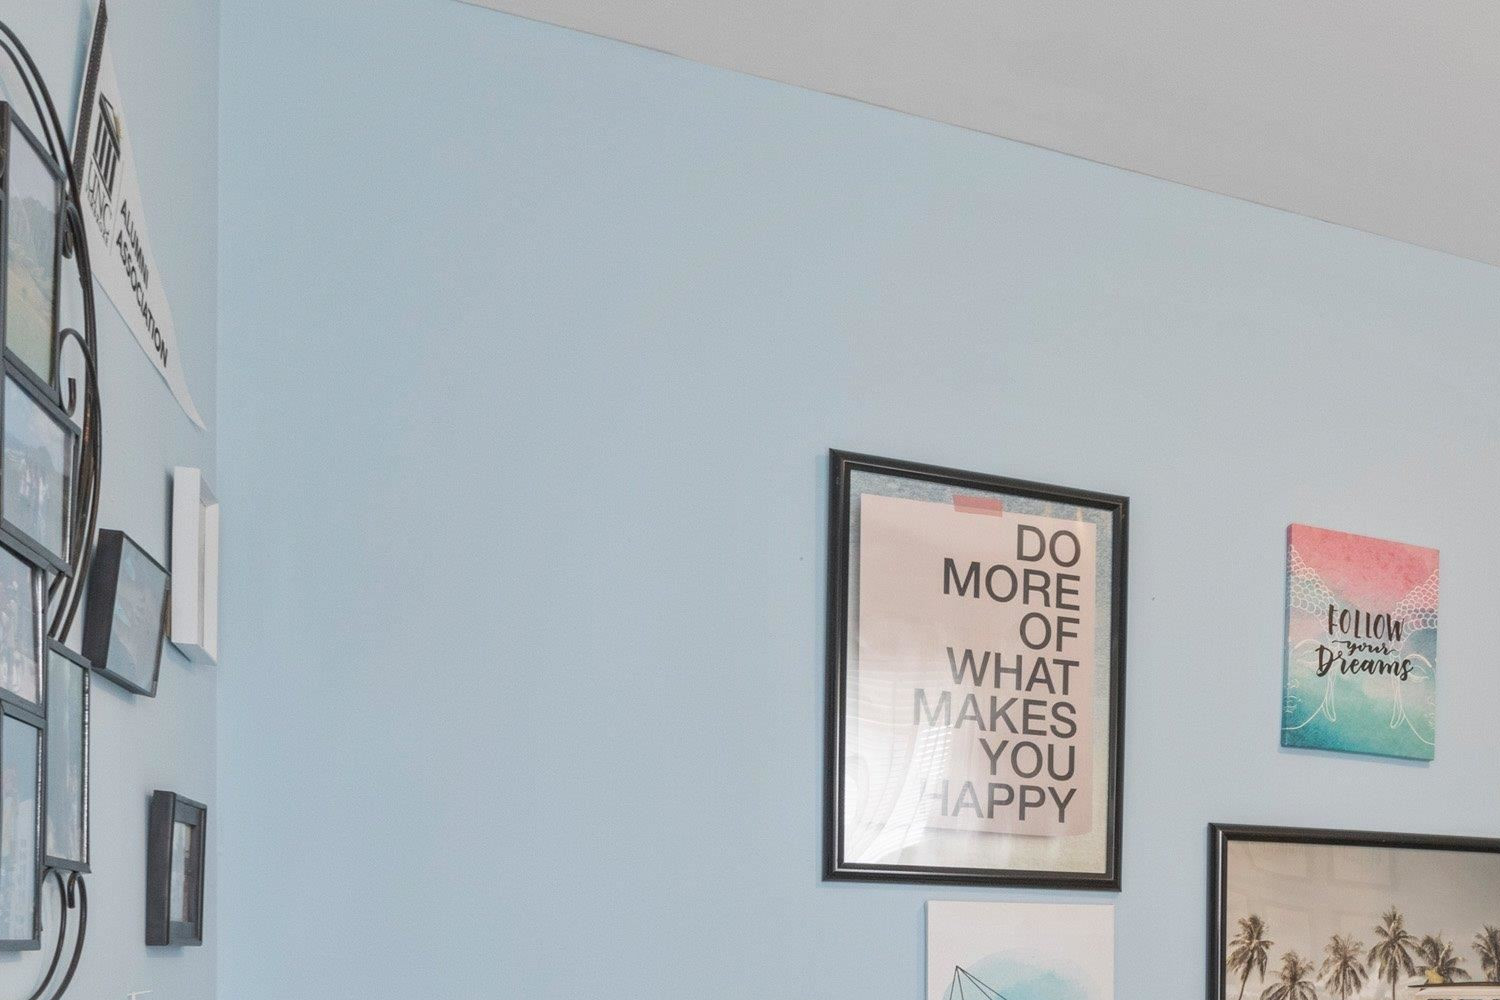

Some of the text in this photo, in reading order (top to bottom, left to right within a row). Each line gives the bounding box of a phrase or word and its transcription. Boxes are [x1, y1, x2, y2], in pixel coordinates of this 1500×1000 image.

[120, 200, 149, 289] ALUMNI
[116, 229, 168, 368] ASSOCIATION
[1016, 524, 1081, 567] DO
[943, 558, 1081, 611] MORE
[1019, 612, 1080, 652] OF
[1328, 604, 1405, 641] FOLLOW
[1315, 644, 1414, 681] Dreams
[1332, 639, 1397, 655] your
[947, 646, 1080, 695] WHAT
[913, 688, 1077, 739] MAKES
[979, 737, 1075, 781] YOU
[921, 779, 1077, 823] HAPPY
